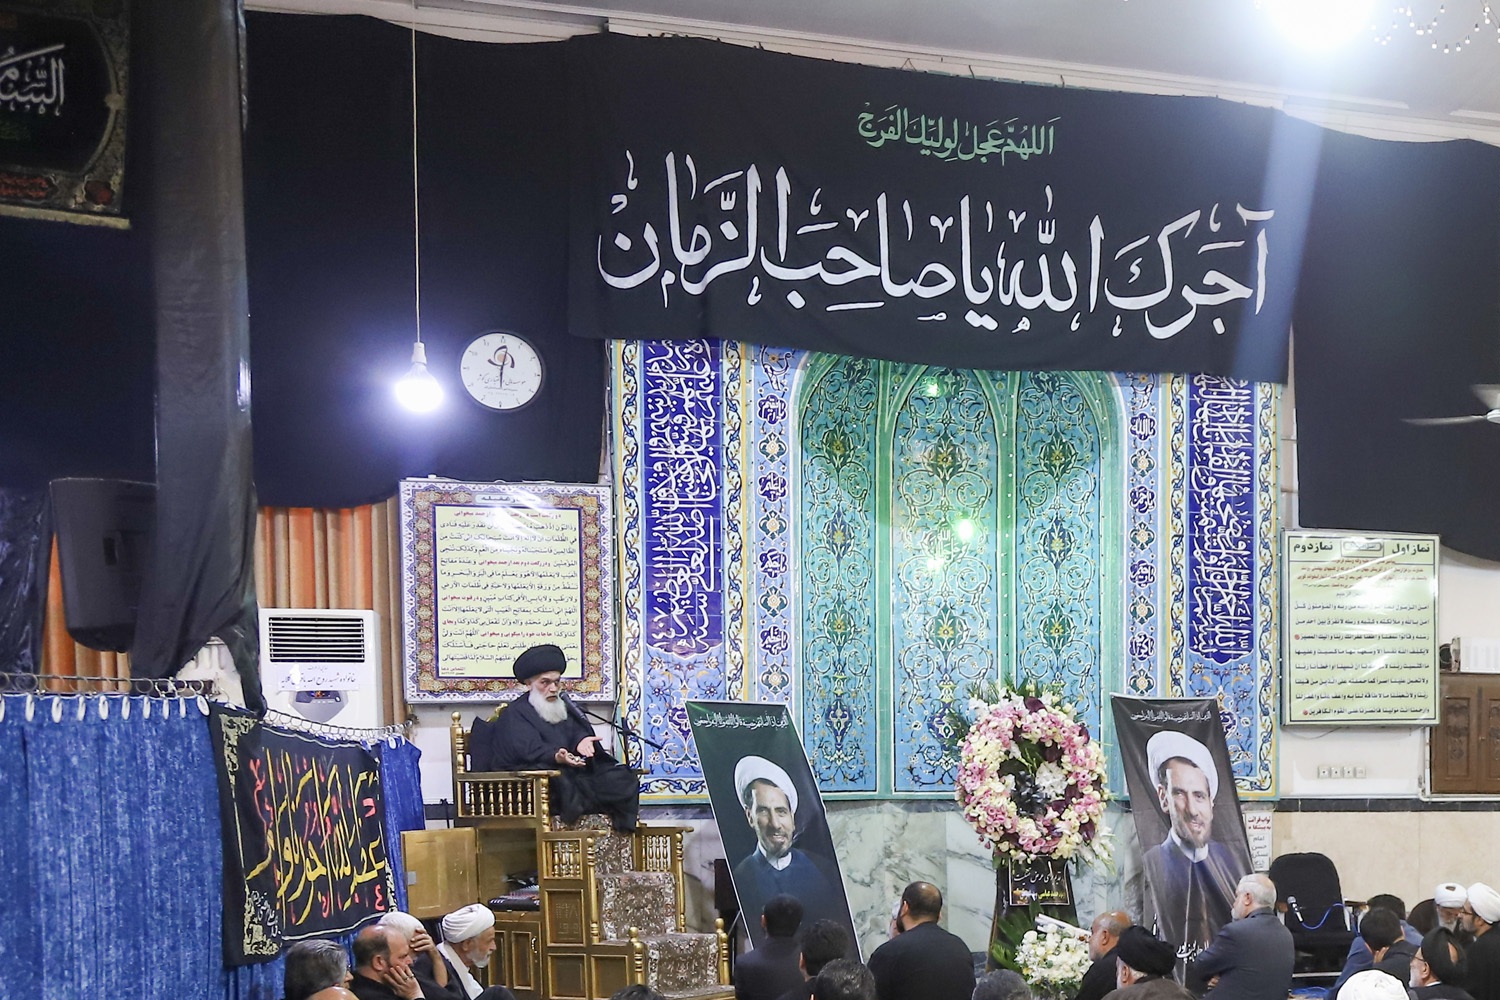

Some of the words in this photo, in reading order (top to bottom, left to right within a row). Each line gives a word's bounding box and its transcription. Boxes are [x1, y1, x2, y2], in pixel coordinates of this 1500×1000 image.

[1293, 542, 1313, 553] دوم
[1313, 541, 1333, 553] نماز
[1411, 545, 1430, 554] نماز
